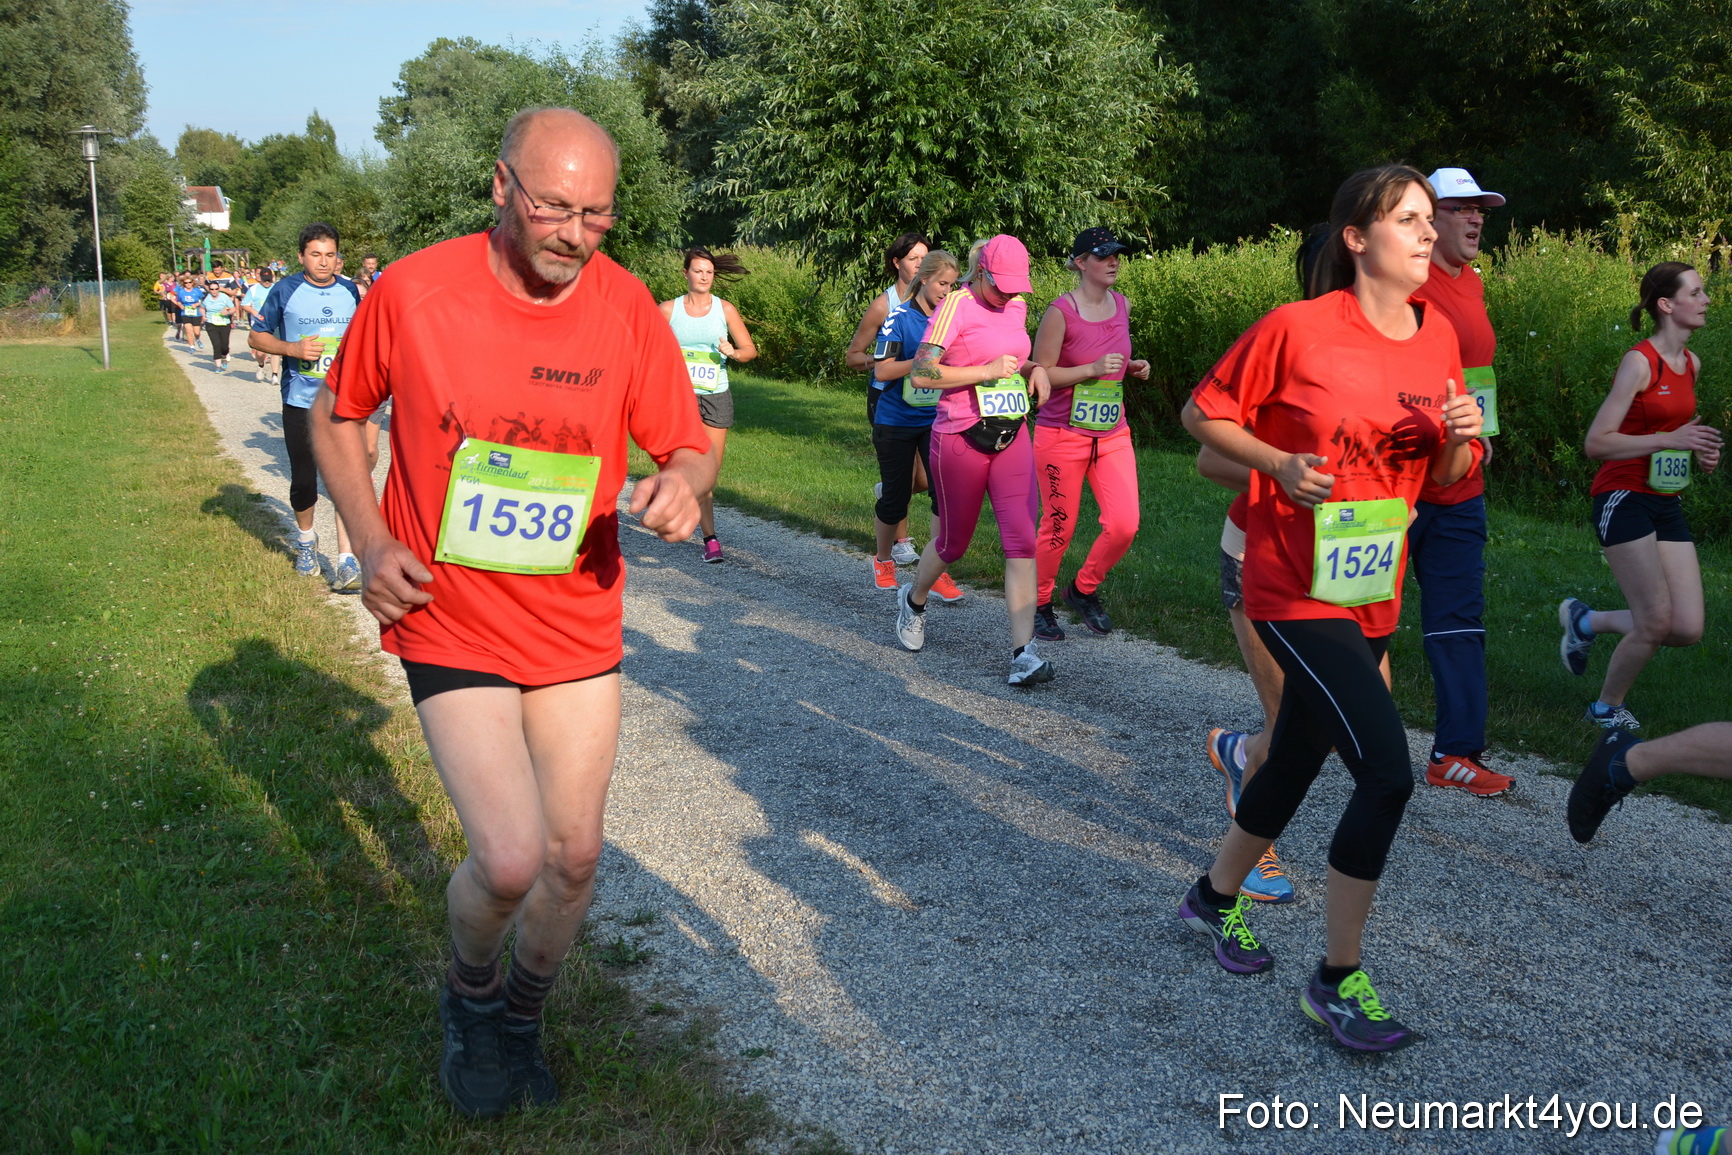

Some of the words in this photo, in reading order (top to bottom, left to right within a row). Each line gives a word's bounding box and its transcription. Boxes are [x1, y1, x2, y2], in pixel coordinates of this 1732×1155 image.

[530, 366, 581, 385] swn
[983, 392, 1027, 415] 5200
[1397, 391, 1432, 408] swn
[1074, 402, 1119, 424] 5199
[476, 462, 530, 480] firmenlauf
[1655, 457, 1688, 477] 1385
[1044, 463, 1067, 502] Chick
[462, 493, 575, 542] 1538
[1326, 540, 1395, 581] 1524
